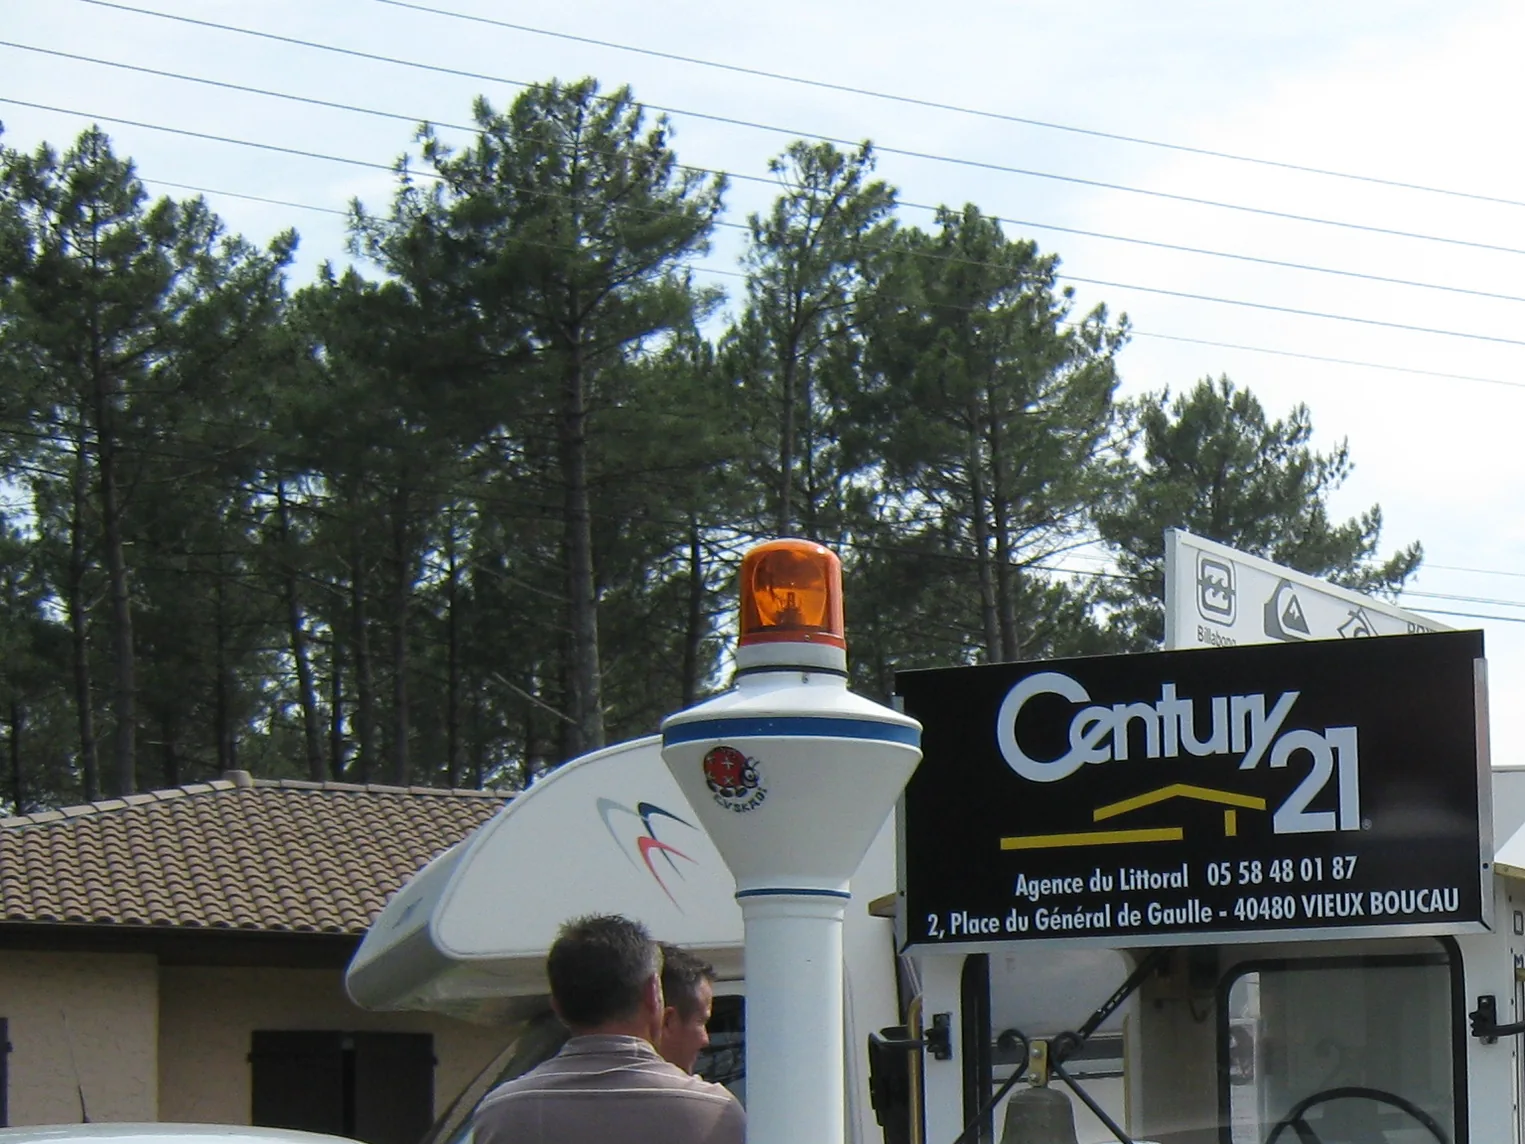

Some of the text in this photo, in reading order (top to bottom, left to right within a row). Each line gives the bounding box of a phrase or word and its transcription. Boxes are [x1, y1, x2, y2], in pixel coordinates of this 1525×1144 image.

[997, 672, 1362, 835] Century 21
[1015, 863, 1189, 902] Agence du Littoral
[1207, 855, 1358, 887] 05 58 48 01 87
[927, 916, 946, 940] 2,
[950, 911, 1001, 936] Place
[1005, 907, 1030, 932] du
[1035, 904, 1113, 932] Général
[1117, 902, 1145, 927] de
[1147, 900, 1214, 926] Gaulle
[1234, 896, 1297, 921] 40480
[1302, 893, 1365, 918] VIEUX
[1370, 889, 1460, 916] BOUCAU
